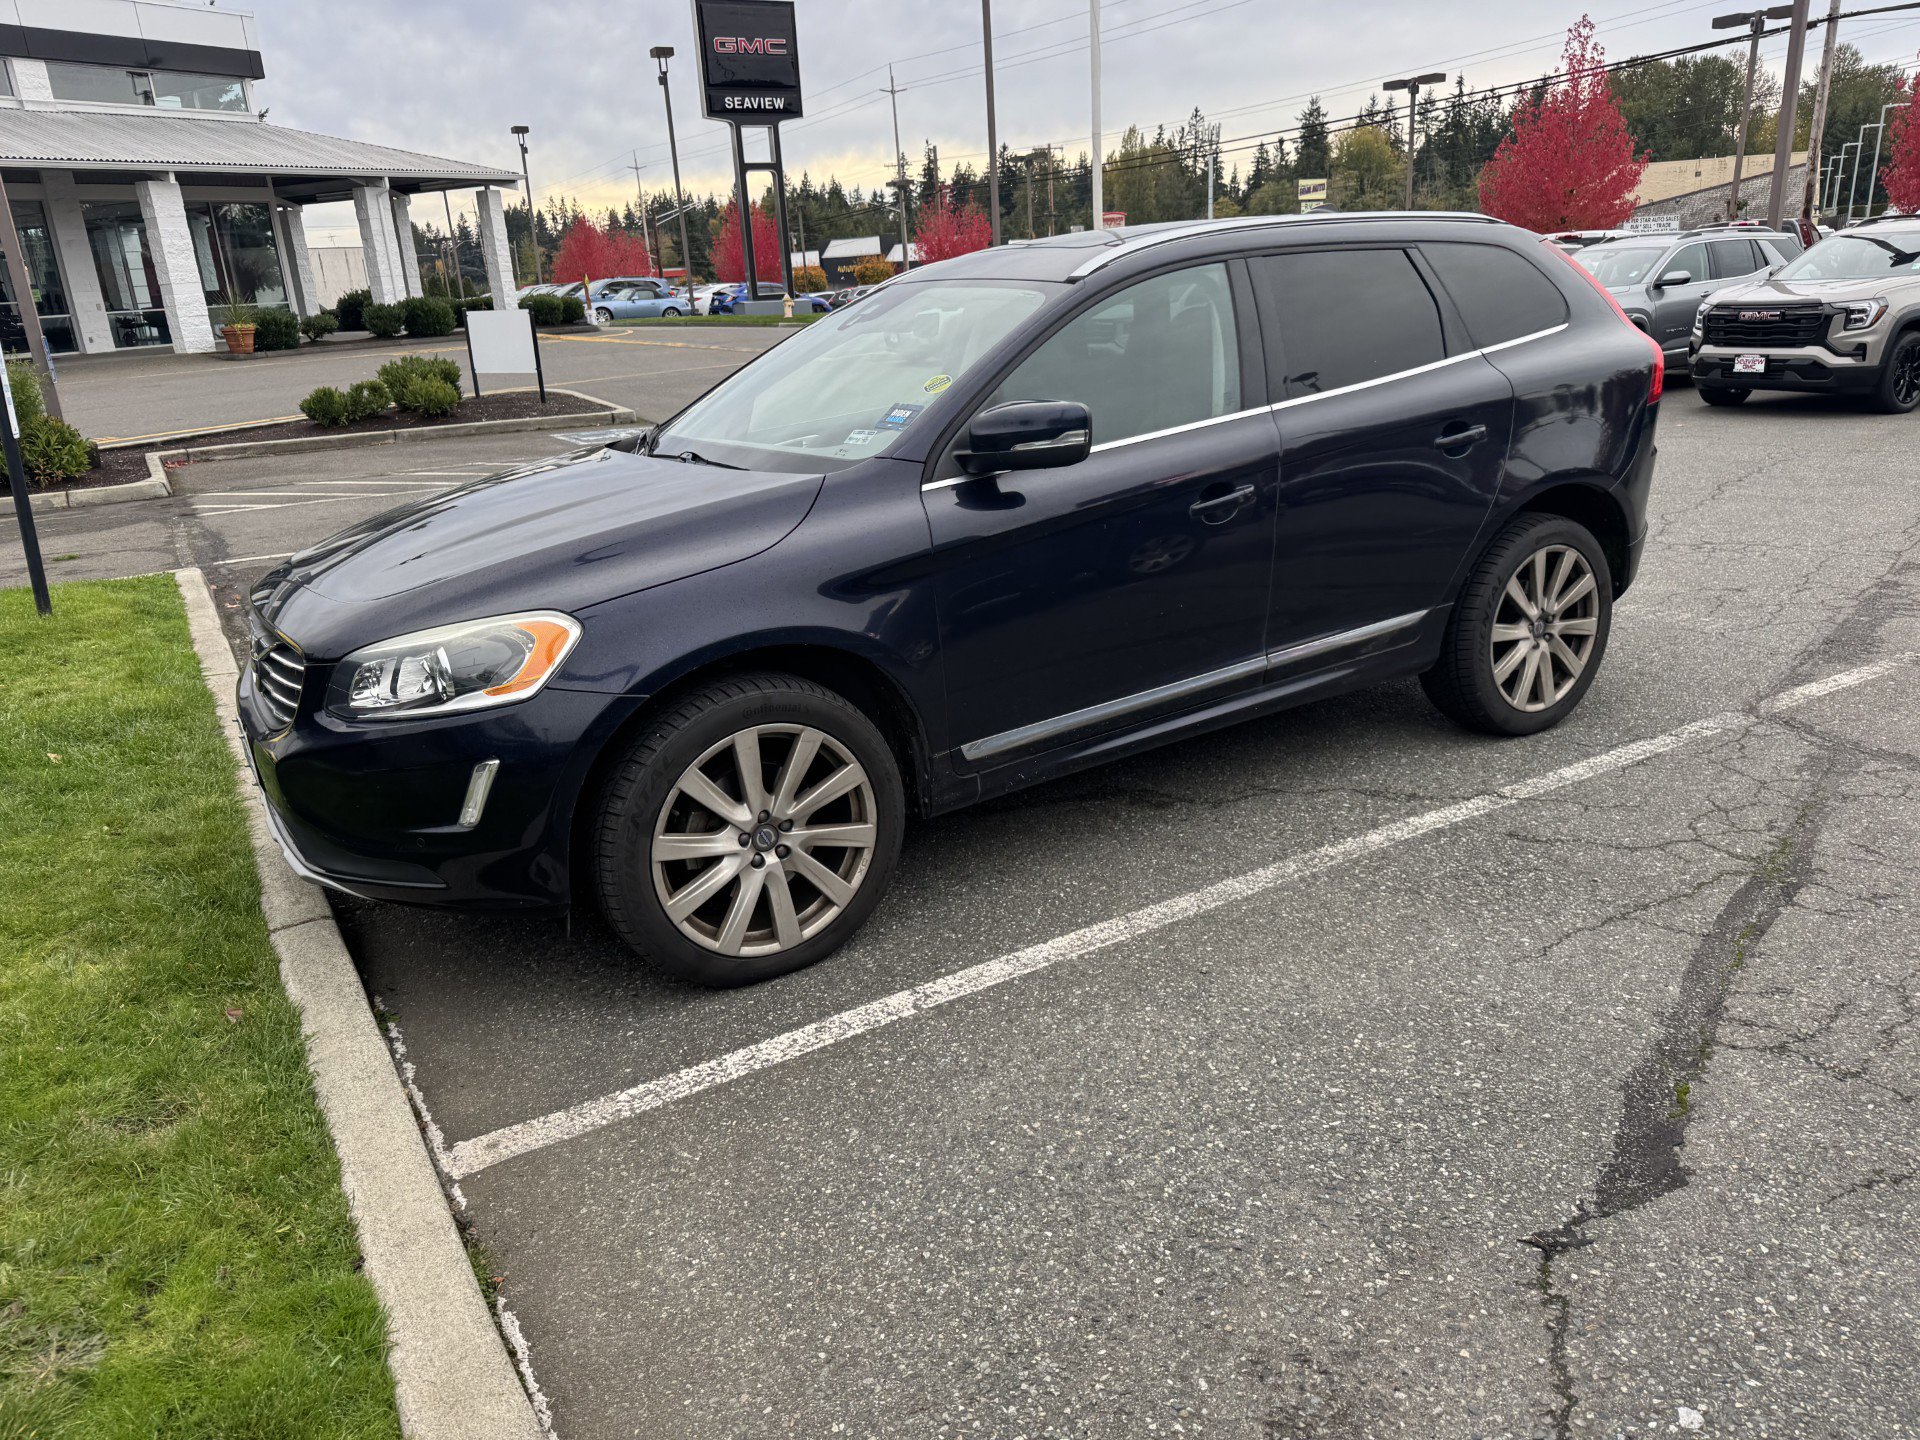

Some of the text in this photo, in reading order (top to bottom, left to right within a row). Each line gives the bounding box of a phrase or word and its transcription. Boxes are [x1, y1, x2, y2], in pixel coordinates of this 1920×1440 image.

[713, 37, 787, 54] GMC
[724, 97, 784, 110] SEAVIEW
[1739, 311, 1780, 320] GMC
[1735, 357, 1765, 365] Seaview
